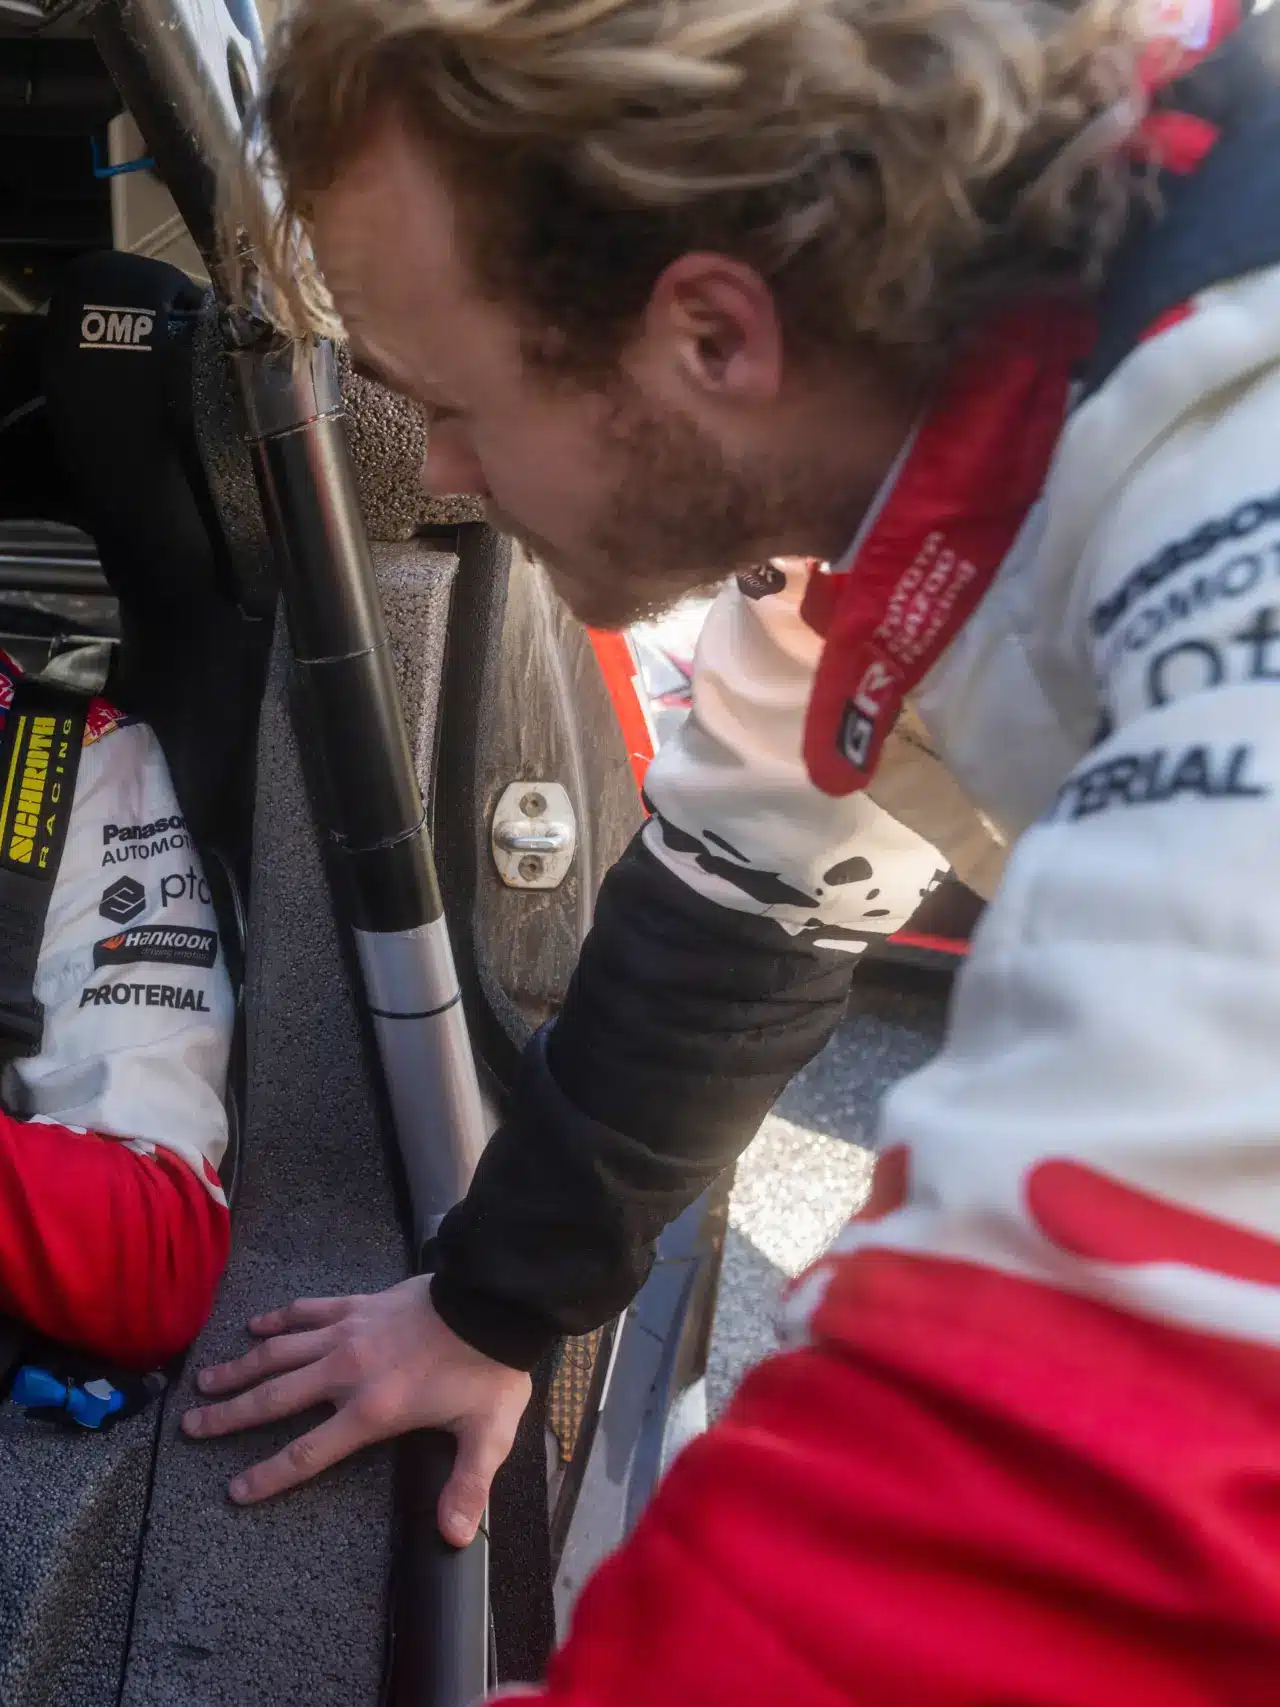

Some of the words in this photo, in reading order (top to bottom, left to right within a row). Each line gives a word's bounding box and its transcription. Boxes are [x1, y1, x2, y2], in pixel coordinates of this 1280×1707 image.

[81, 312, 154, 344] OMP
[9, 716, 57, 864] SCHROTH
[38, 718, 73, 869] RACING
[79, 983, 211, 1013] PROTERIAL
